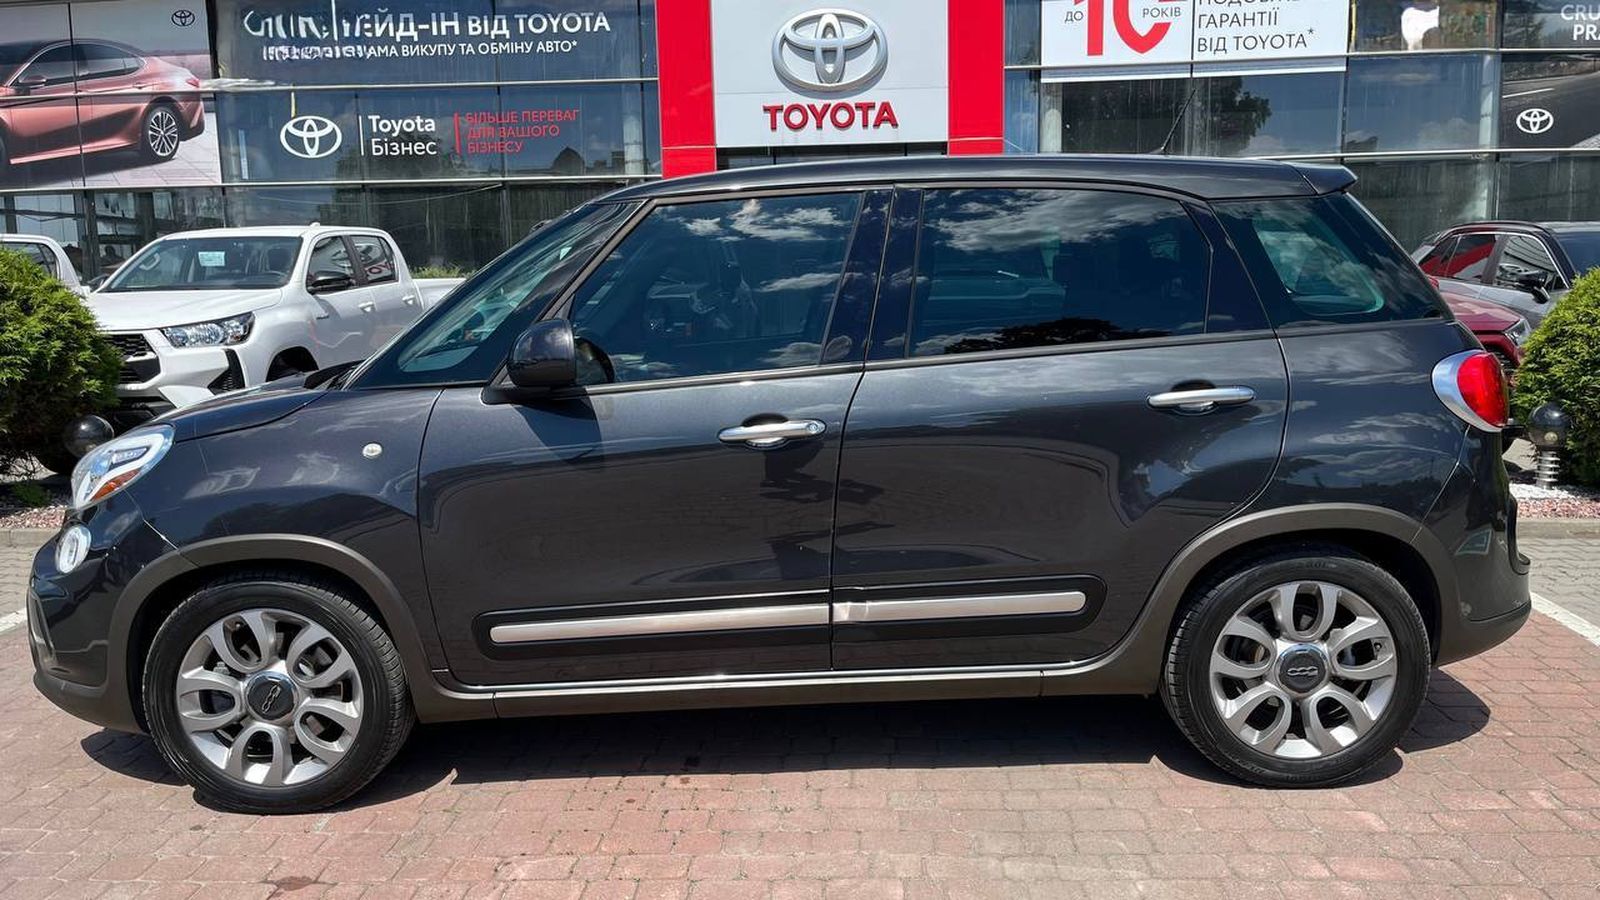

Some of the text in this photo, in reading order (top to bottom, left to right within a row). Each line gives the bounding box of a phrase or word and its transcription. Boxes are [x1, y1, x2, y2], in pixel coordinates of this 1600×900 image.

[1064, 11, 1084, 23] ДО
[1142, 7, 1181, 18] РОКІВ
[1198, 7, 1280, 28] ГАРАНТІЇ
[467, 15, 511, 39] ВІД
[514, 12, 611, 34] TOYOTA
[1573, 24, 1600, 40] PR
[402, 44, 455, 57] ВИКУПУ
[458, 43, 475, 55] ТА
[478, 41, 533, 54] ОБМІНУ
[1197, 37, 1227, 54] ВІД
[465, 109, 580, 123] БІЛЬШЕ ПЕРЕВАГ
[763, 101, 899, 132] TOYOTA
[368, 115, 436, 137] Toyota
[499, 124, 560, 138] ВАШОГО
[371, 138, 437, 156] Бізнес
[467, 141, 524, 153] БІЗНЕСУ
